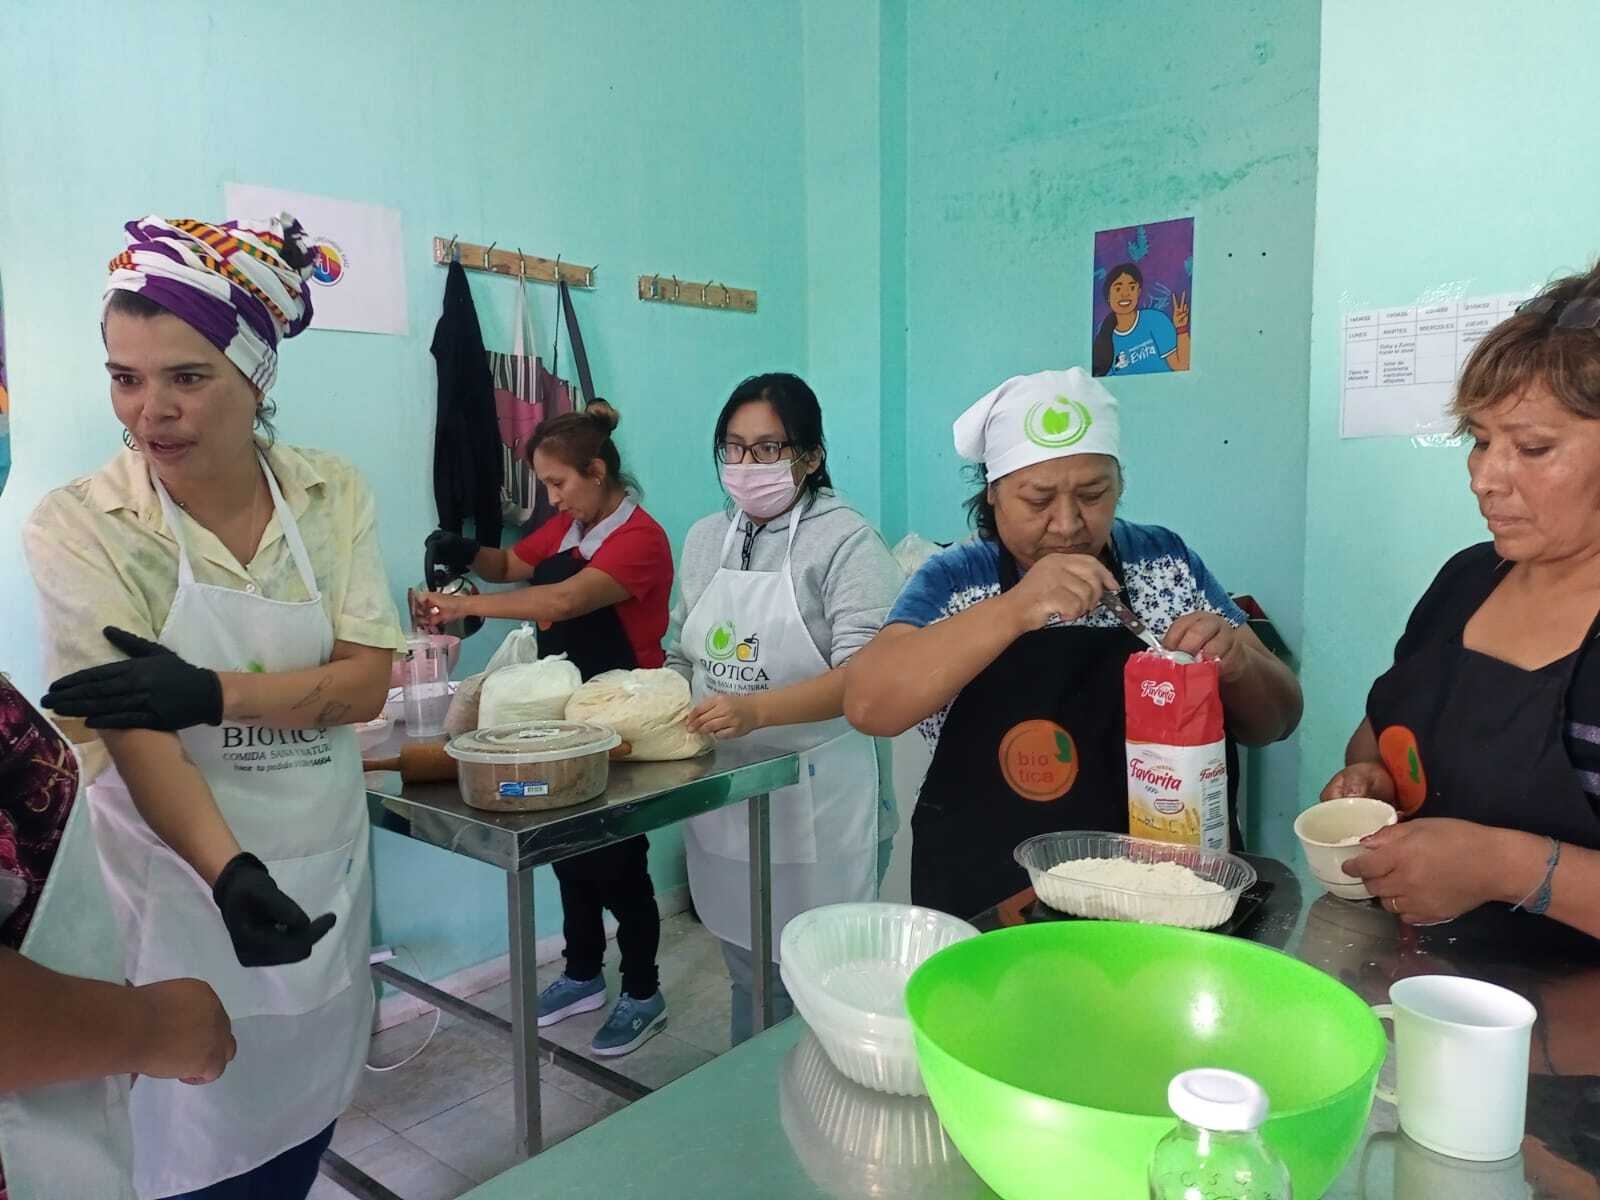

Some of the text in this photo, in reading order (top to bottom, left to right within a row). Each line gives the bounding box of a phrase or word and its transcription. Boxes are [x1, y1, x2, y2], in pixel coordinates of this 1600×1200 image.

[1130, 344, 1157, 364] Evita
[1142, 681, 1175, 702] Favorita
[223, 751, 267, 762] COMIDA
[1018, 751, 1049, 766] bio
[1018, 769, 1055, 784] tica
[1130, 758, 1182, 791] Favorita
